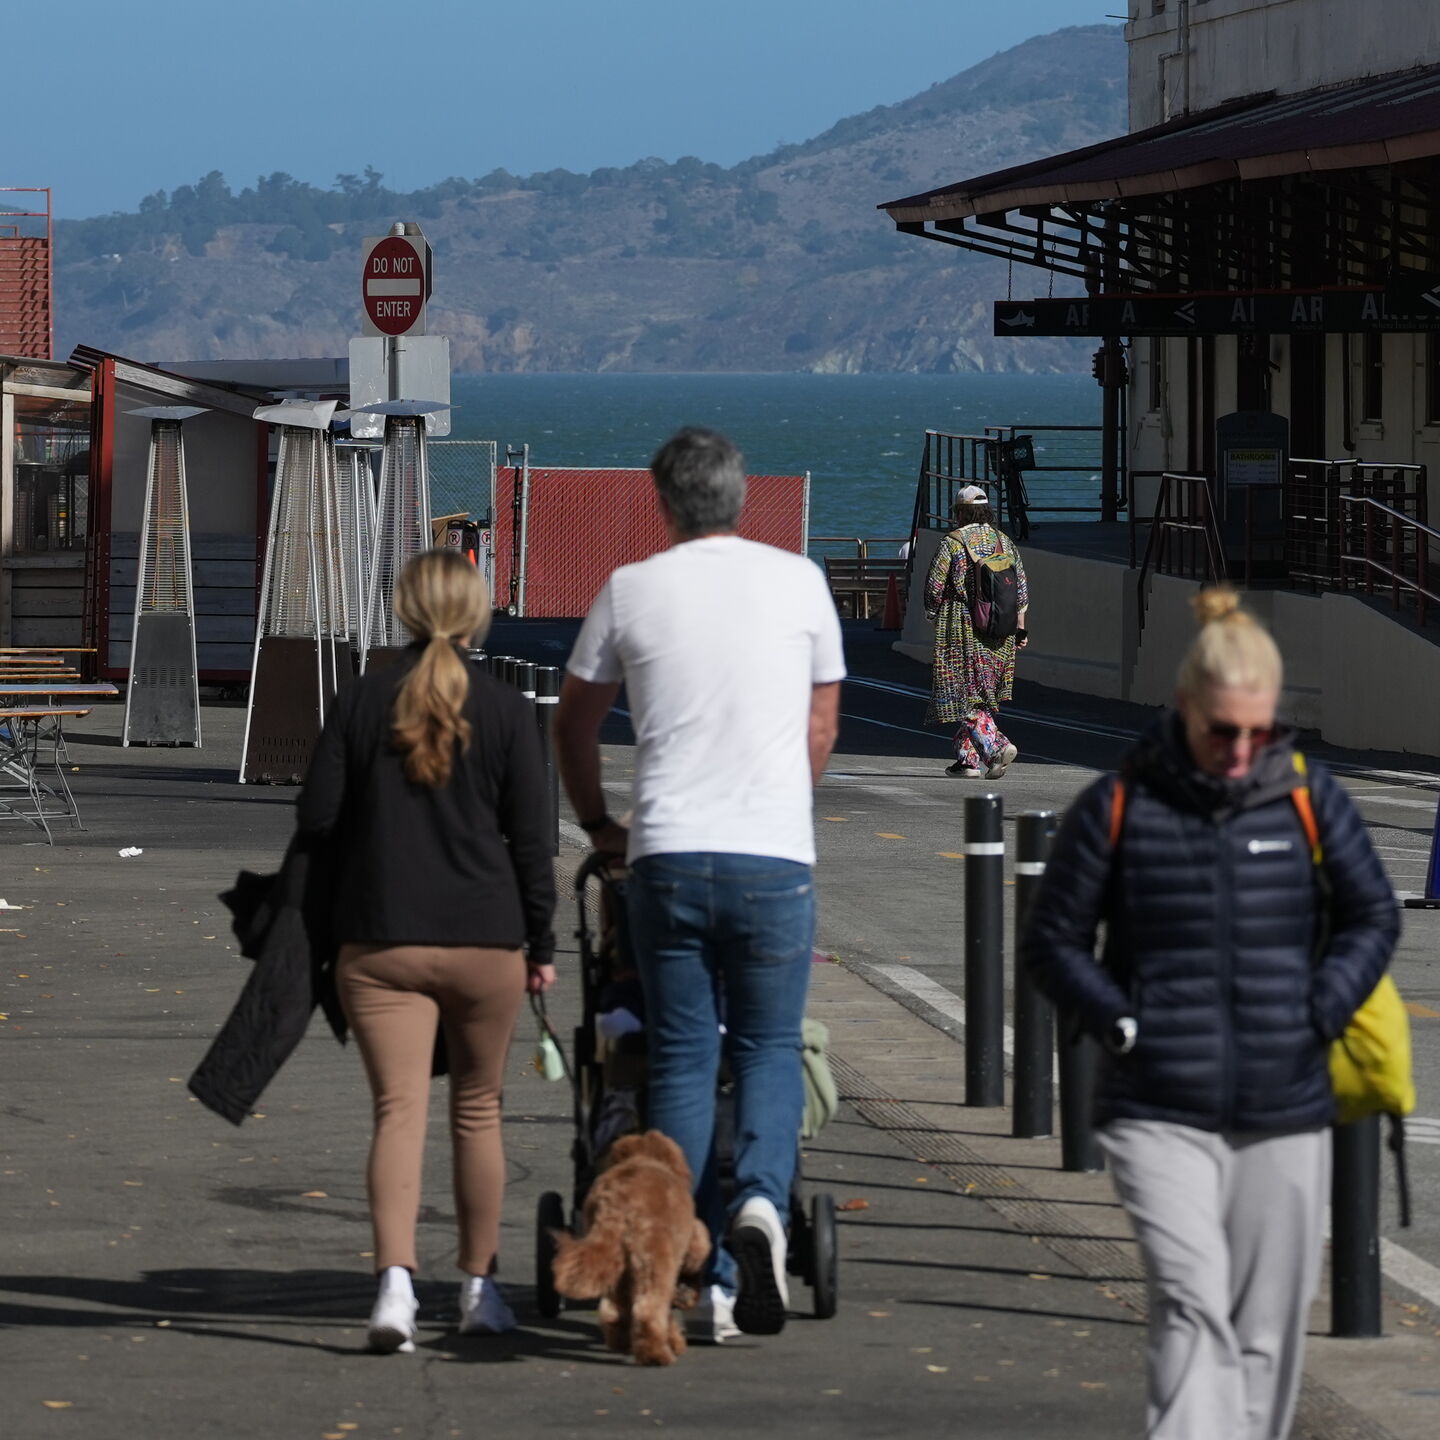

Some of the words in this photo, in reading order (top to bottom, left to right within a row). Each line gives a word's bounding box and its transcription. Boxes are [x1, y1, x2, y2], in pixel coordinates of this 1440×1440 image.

[373, 257, 388, 273] DO
[393, 257, 414, 273] NOT
[376, 301, 411, 317] ENTER
